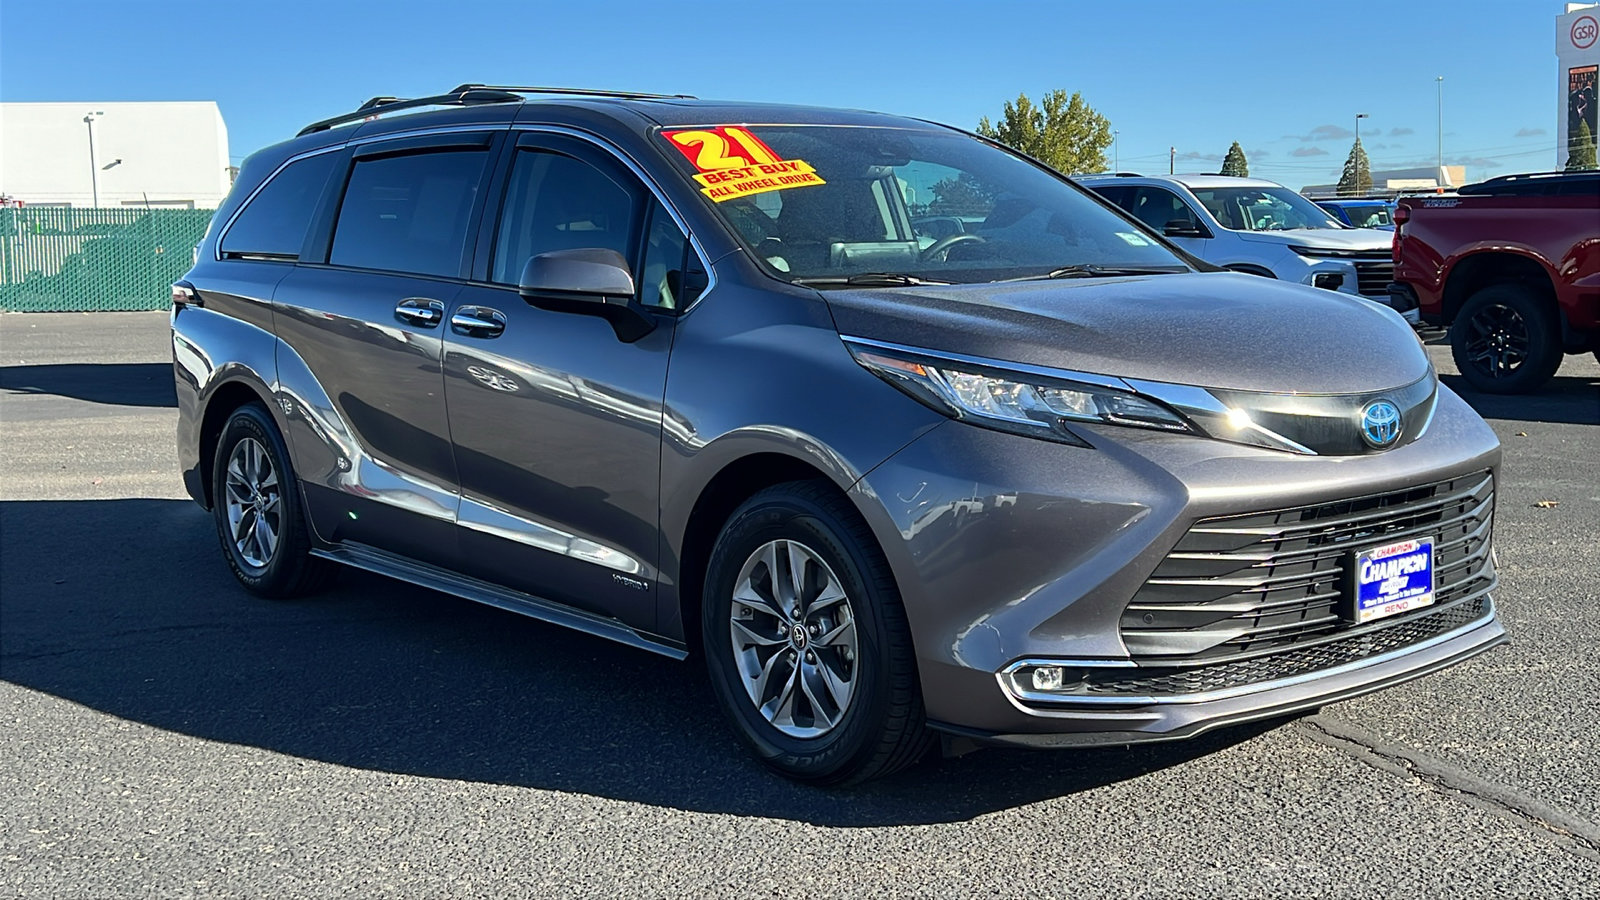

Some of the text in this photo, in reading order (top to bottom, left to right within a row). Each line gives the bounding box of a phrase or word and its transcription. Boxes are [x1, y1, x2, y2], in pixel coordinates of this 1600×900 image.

[1574, 25, 1594, 40] GSR
[672, 127, 775, 170] 21
[703, 161, 801, 184] BEST BUY
[709, 173, 816, 198] ALL WHEEL DRIVE
[1376, 543, 1413, 558] CHAMPION
[1360, 553, 1428, 584] CHAMPION
[1385, 601, 1408, 613] RENO
